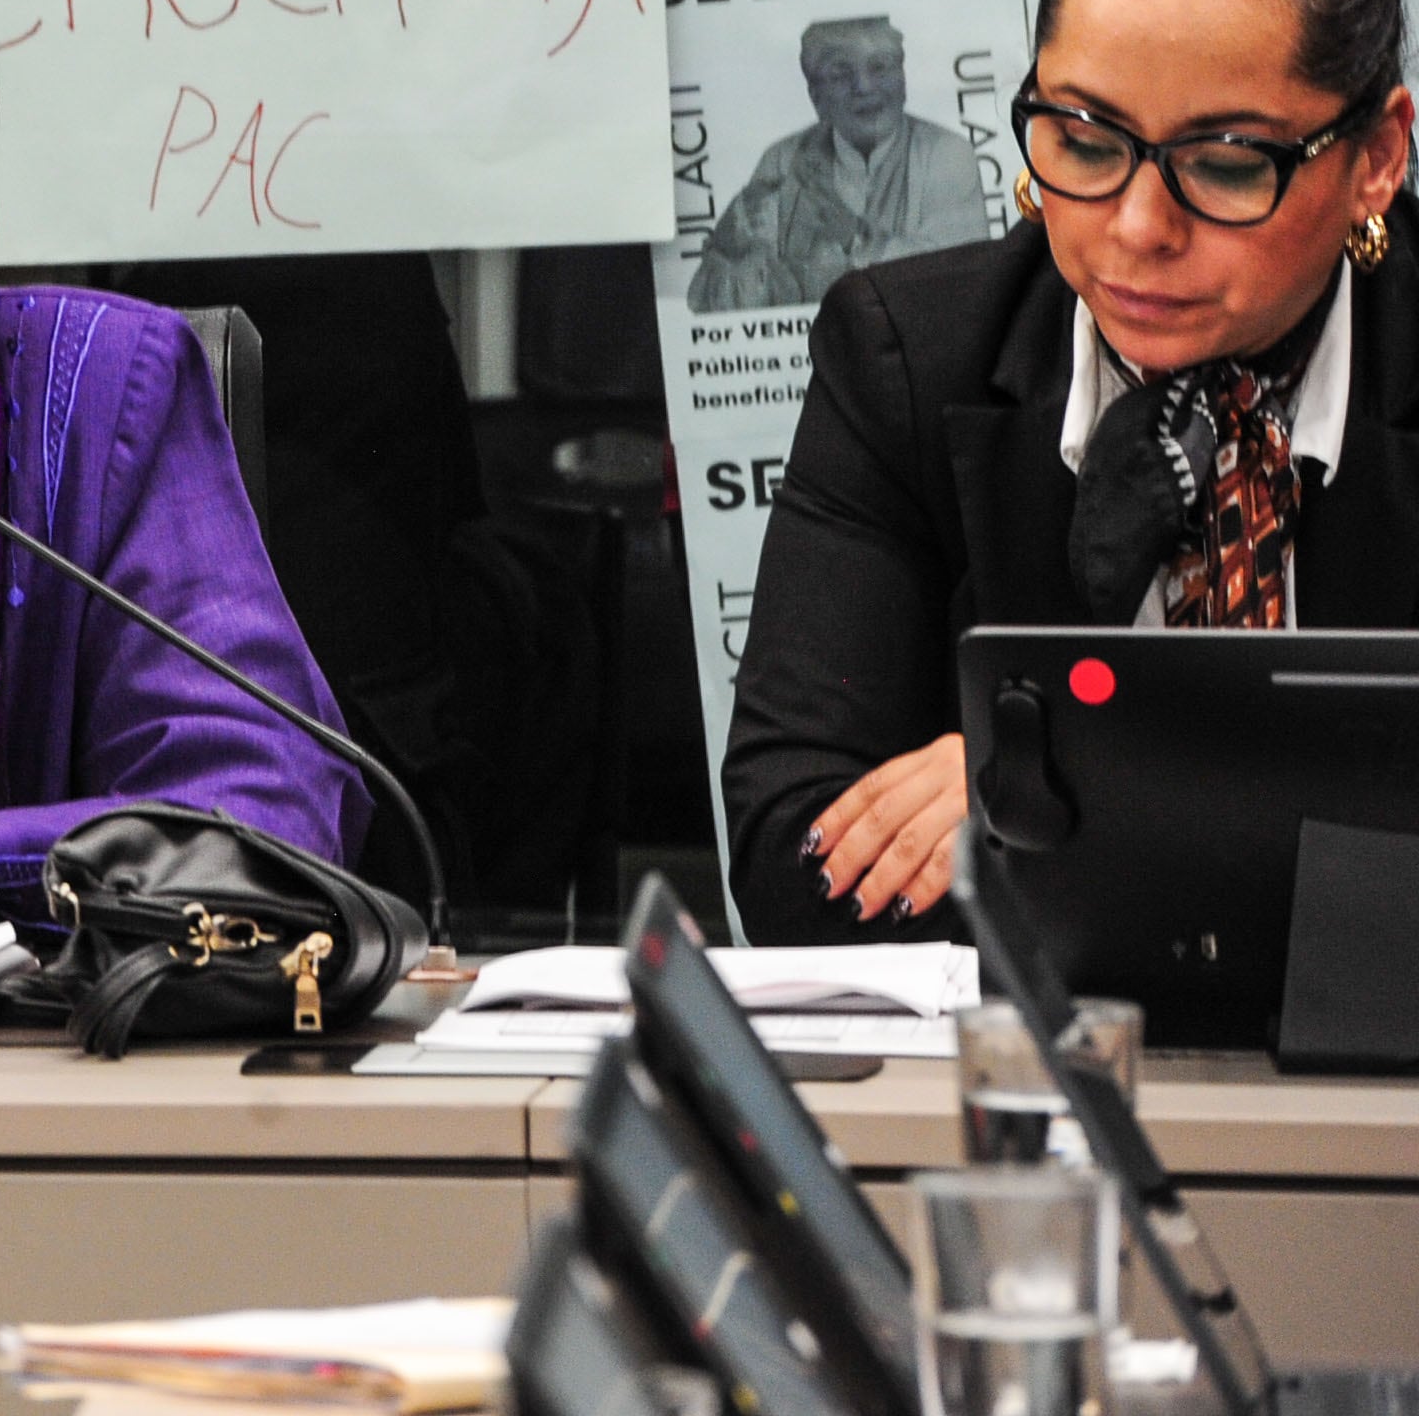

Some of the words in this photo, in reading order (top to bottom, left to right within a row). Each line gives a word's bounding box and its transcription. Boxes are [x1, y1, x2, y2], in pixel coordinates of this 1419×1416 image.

[149, 85, 331, 228] PAC
[691, 326, 734, 345] Por
[688, 353, 782, 378] Pública
